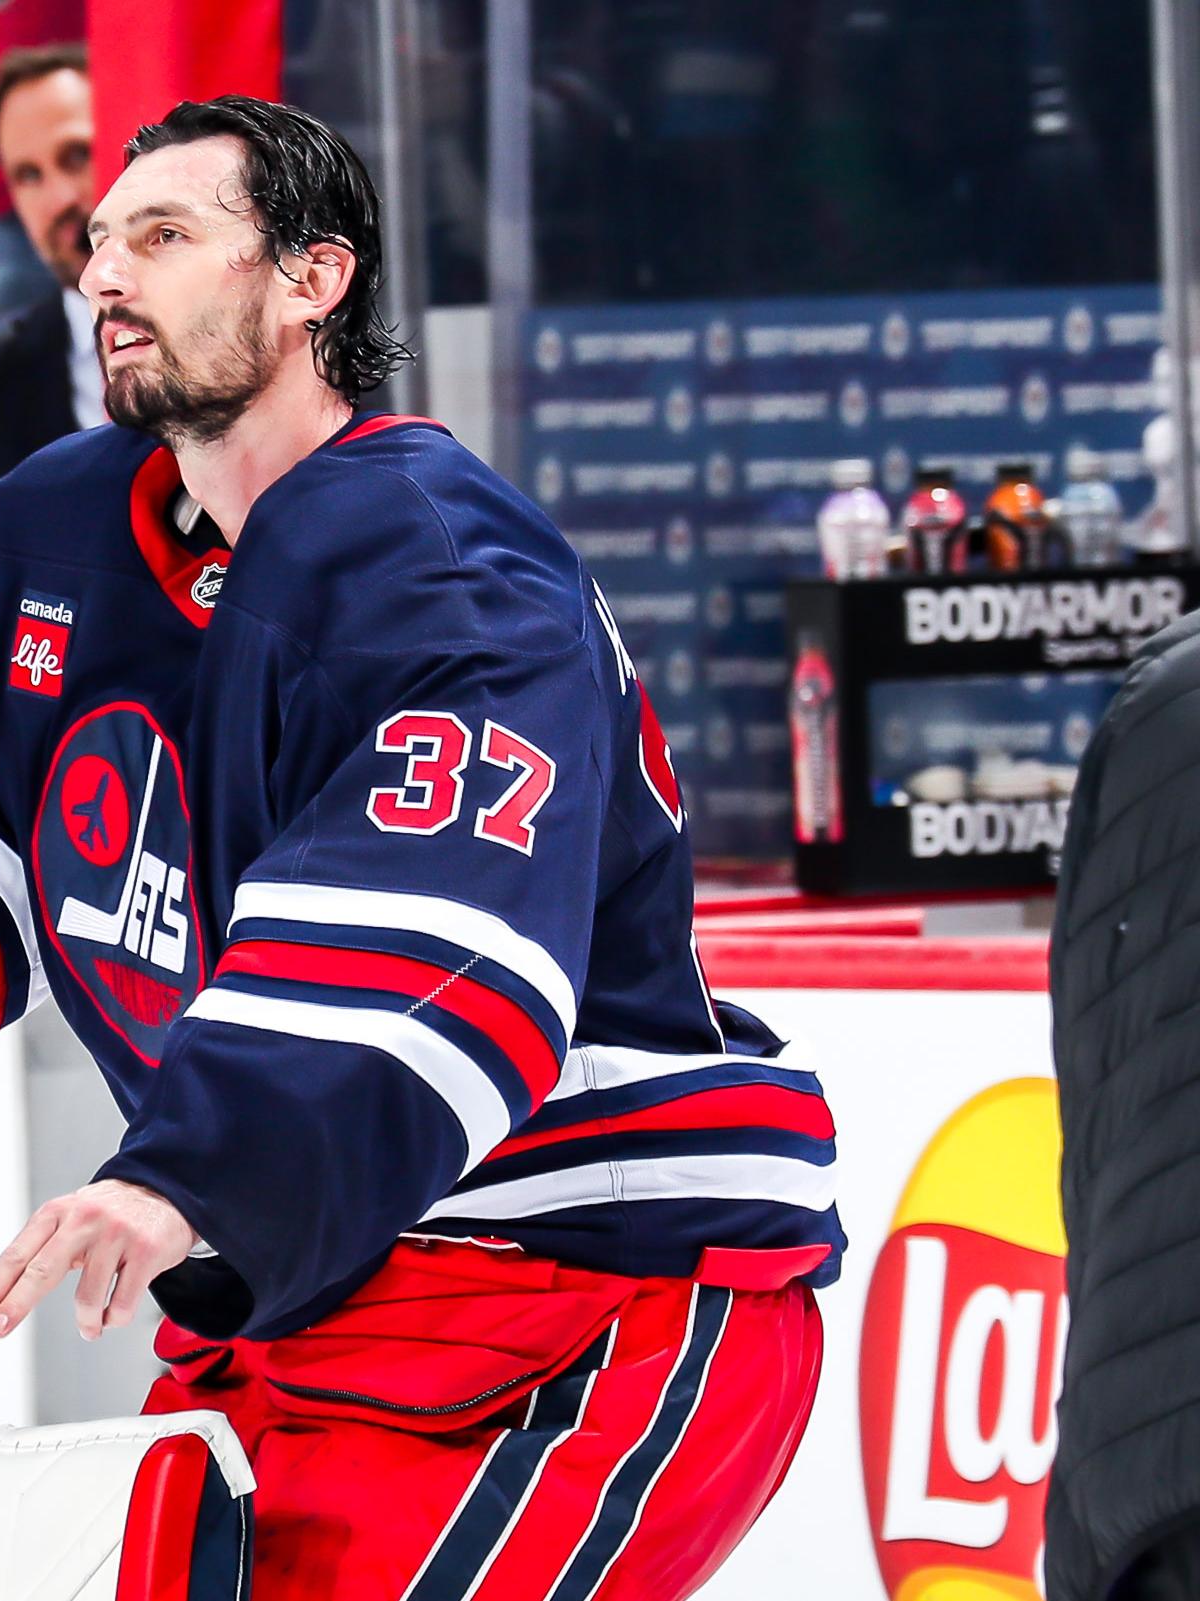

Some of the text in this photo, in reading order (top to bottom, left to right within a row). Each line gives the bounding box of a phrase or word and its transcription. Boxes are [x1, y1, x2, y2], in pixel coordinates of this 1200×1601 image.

[20, 598, 73, 625] canada
[903, 576, 1186, 644] BODYARMOR
[11, 634, 63, 686] life
[365, 710, 557, 858] 37
[57, 734, 188, 975] JETS
[910, 800, 1071, 858] BODYA
